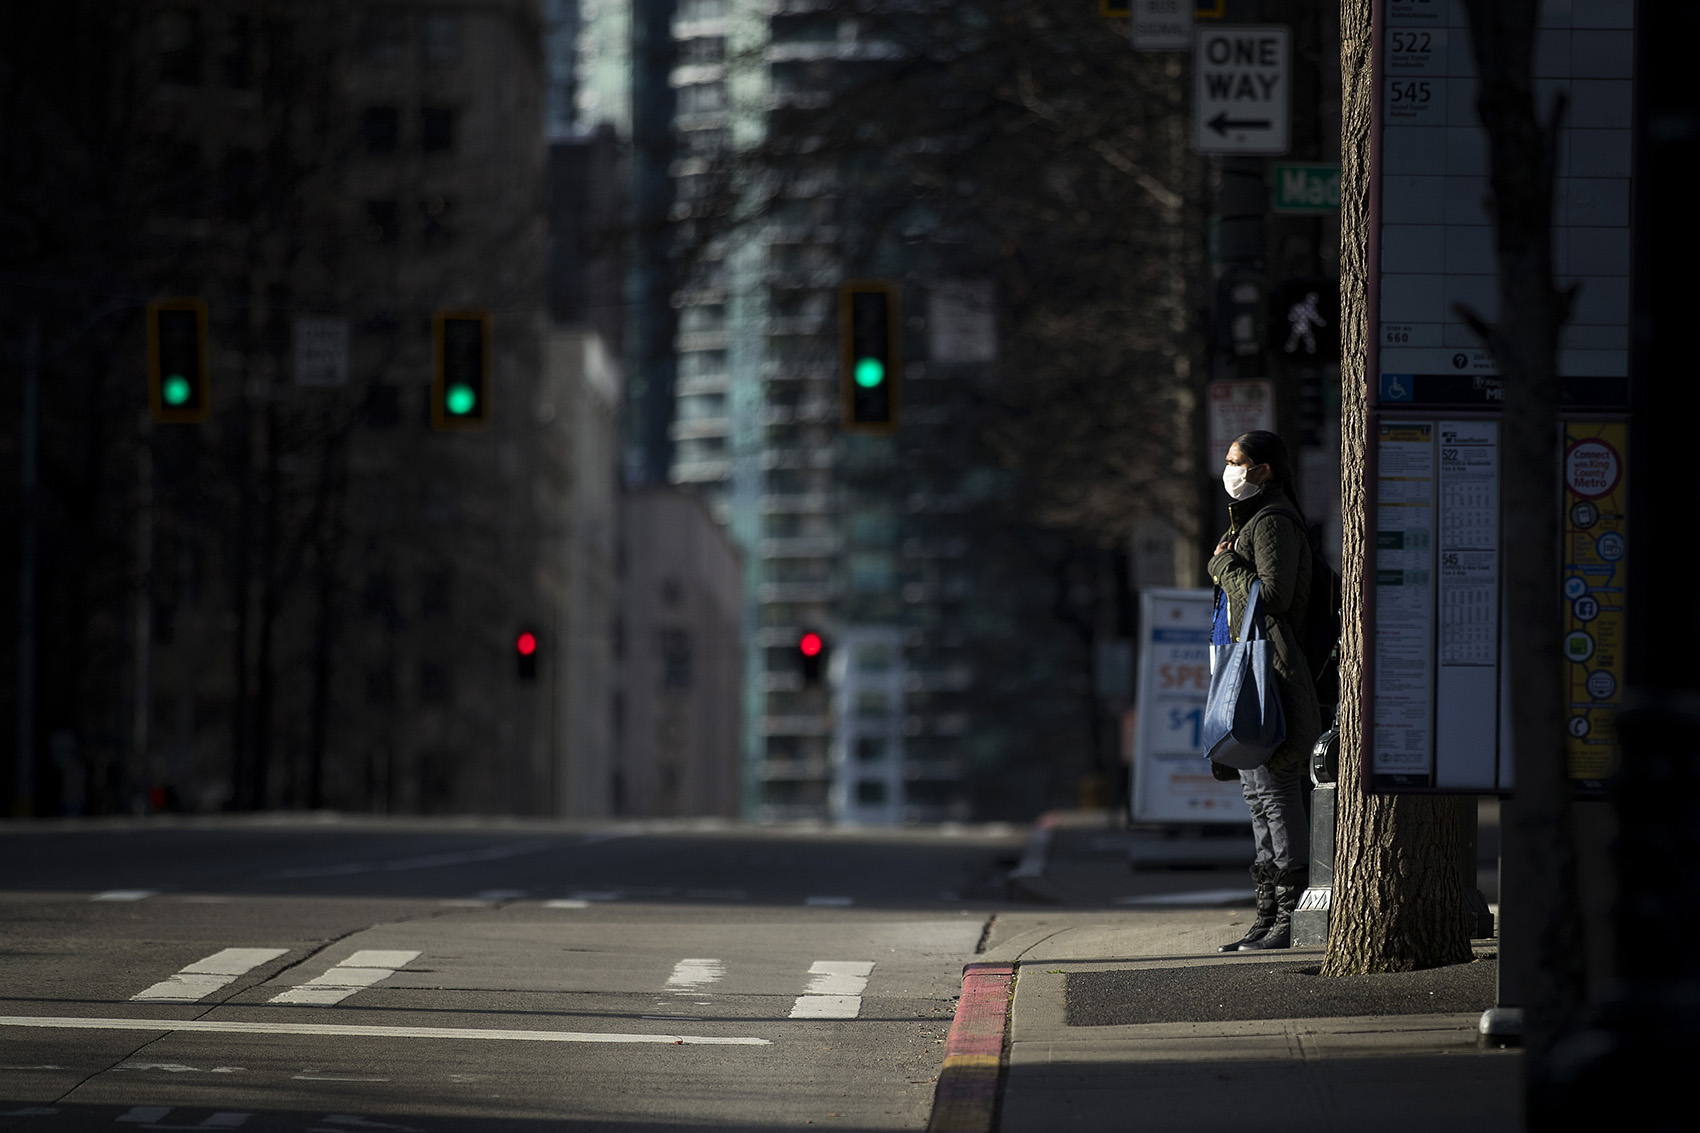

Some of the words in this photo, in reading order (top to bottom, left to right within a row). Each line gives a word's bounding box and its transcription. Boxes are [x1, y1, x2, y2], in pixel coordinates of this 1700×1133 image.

[1392, 32, 1431, 52] 522
[1207, 37, 1279, 65] ONE
[1205, 73, 1280, 100] WAY
[1391, 81, 1431, 102] 545
[1387, 333, 1409, 343] 660
[1442, 449, 1458, 461] 522
[1574, 450, 1609, 459] Connect
[1590, 460, 1609, 471] King
[1574, 469, 1606, 480] County
[1574, 478, 1607, 488] Metro
[1442, 553, 1458, 565] 545
